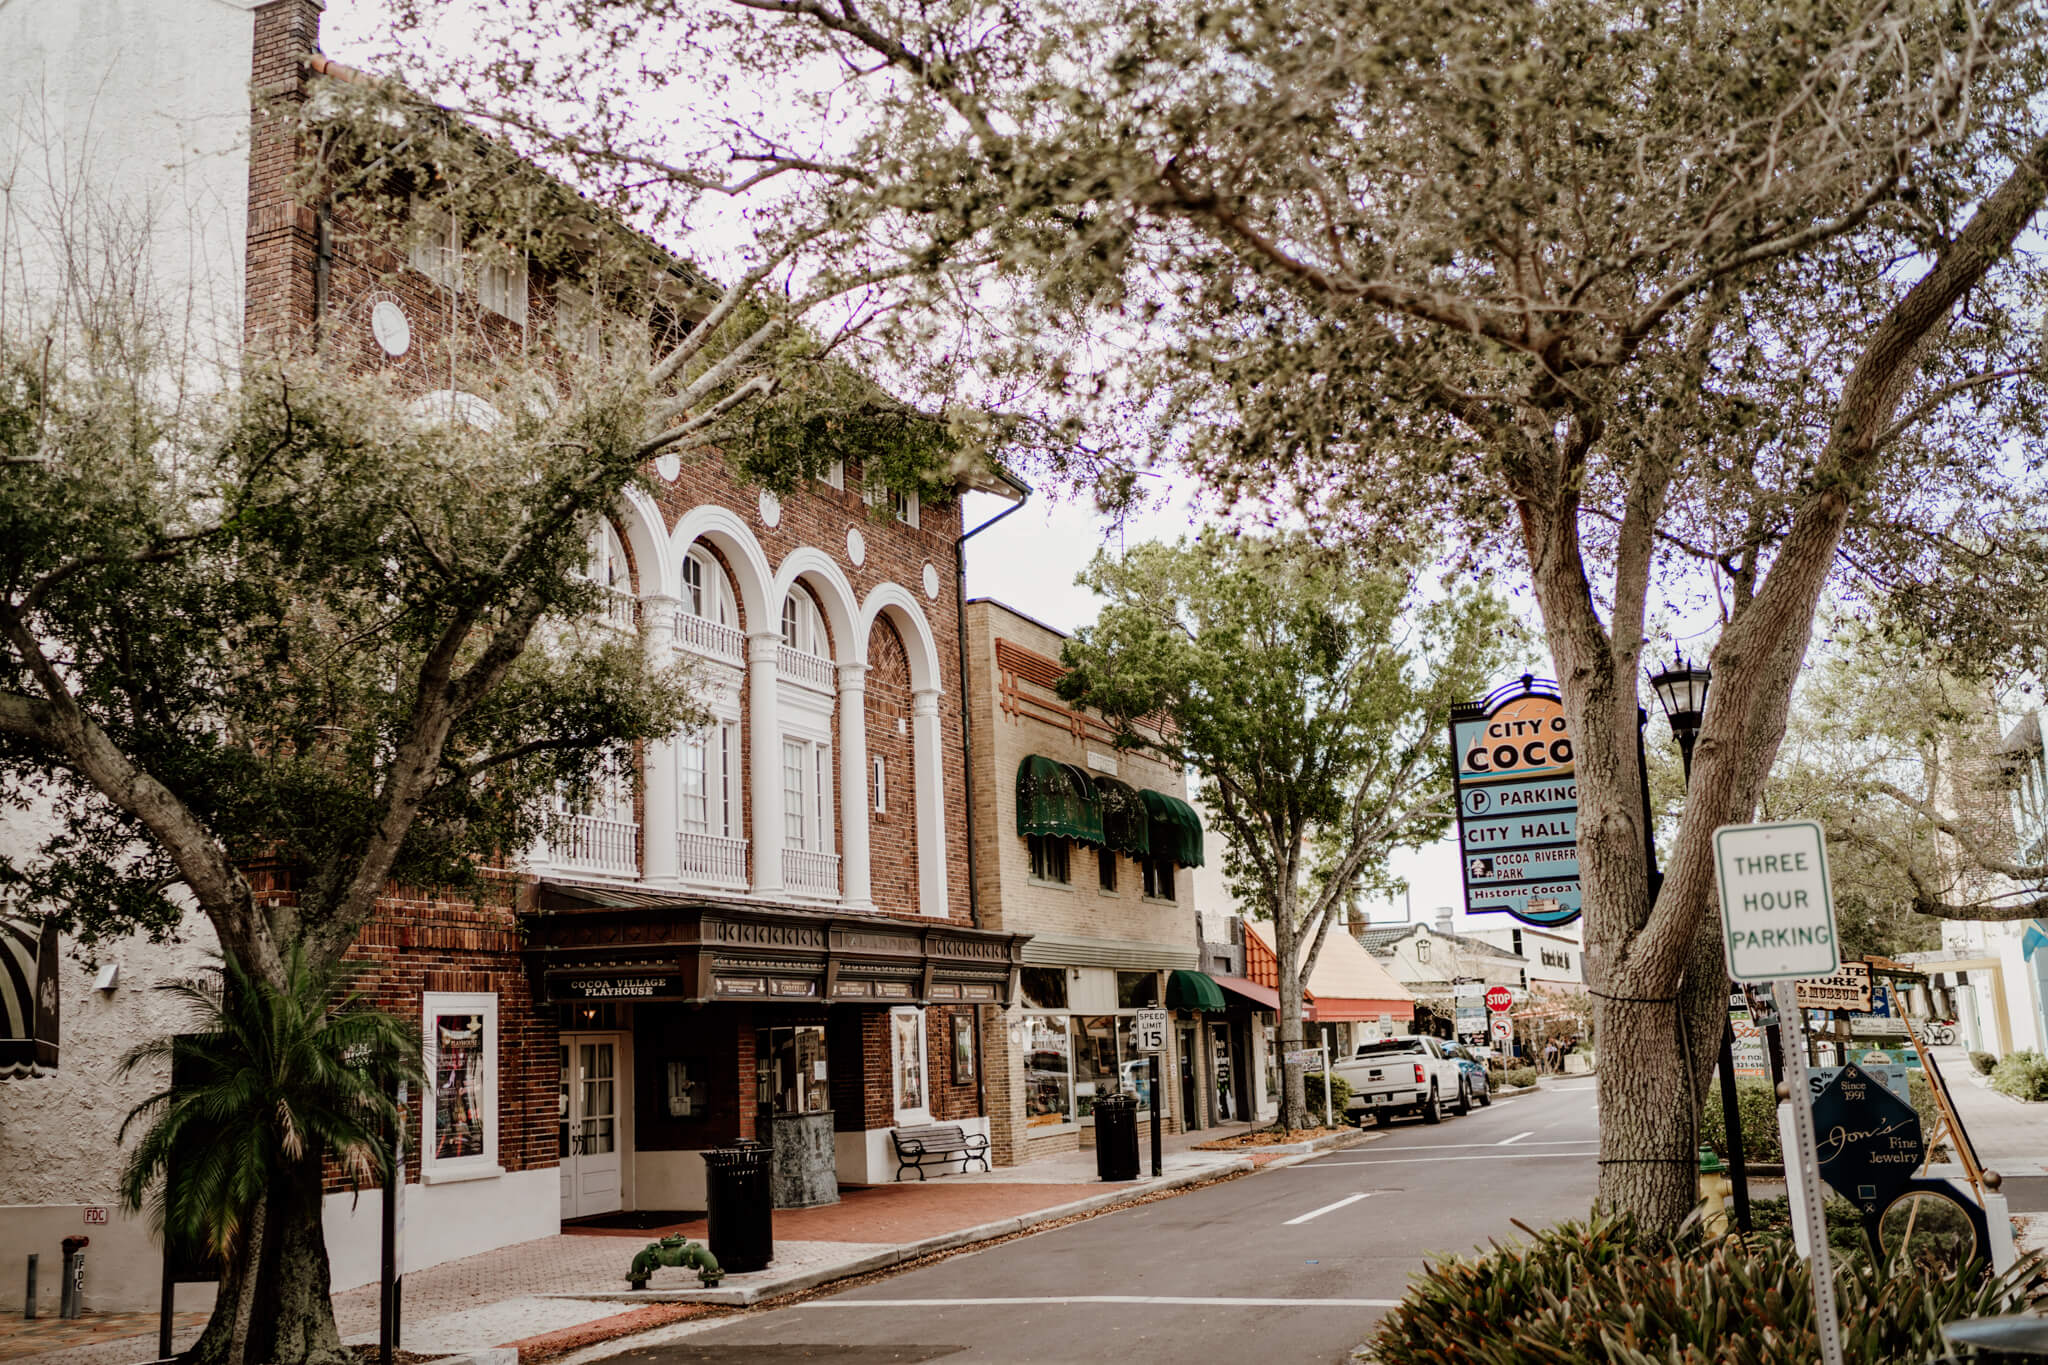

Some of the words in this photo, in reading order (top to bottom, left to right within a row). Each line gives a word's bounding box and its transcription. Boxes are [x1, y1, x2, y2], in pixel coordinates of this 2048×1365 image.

[1488, 719, 1543, 738] CITY
[1473, 793, 1485, 811] P
[1500, 785, 1577, 806] PARKING
[1468, 826, 1509, 842] CITY
[1521, 821, 1570, 839] HALL
[1495, 853, 1530, 866] COCOA
[1535, 849, 1577, 863] RIVERFR
[1734, 852, 1808, 875] THREE
[1496, 868, 1524, 880] PARK
[1474, 888, 1528, 899] Historic
[1531, 884, 1572, 895] Cocoa
[1743, 889, 1808, 912] HOUR
[1732, 925, 1829, 950] PARKING
[570, 980, 610, 989] COCOA
[616, 978, 667, 988] VILLAGE
[585, 986, 653, 996] PLAYHOUSE
[1487, 993, 1511, 1005] STOP
[1808, 986, 1859, 1001] MUSEUM
[1142, 1022, 1162, 1030] LIMIT
[1143, 1031, 1162, 1047] 15
[1840, 1081, 1866, 1090] Since
[1844, 1091, 1865, 1100] 1991
[1816, 1117, 1914, 1165] Jon's
[1889, 1137, 1917, 1149] Fine
[1868, 1151, 1918, 1163] Jewelry
[86, 1210, 104, 1221] FDC
